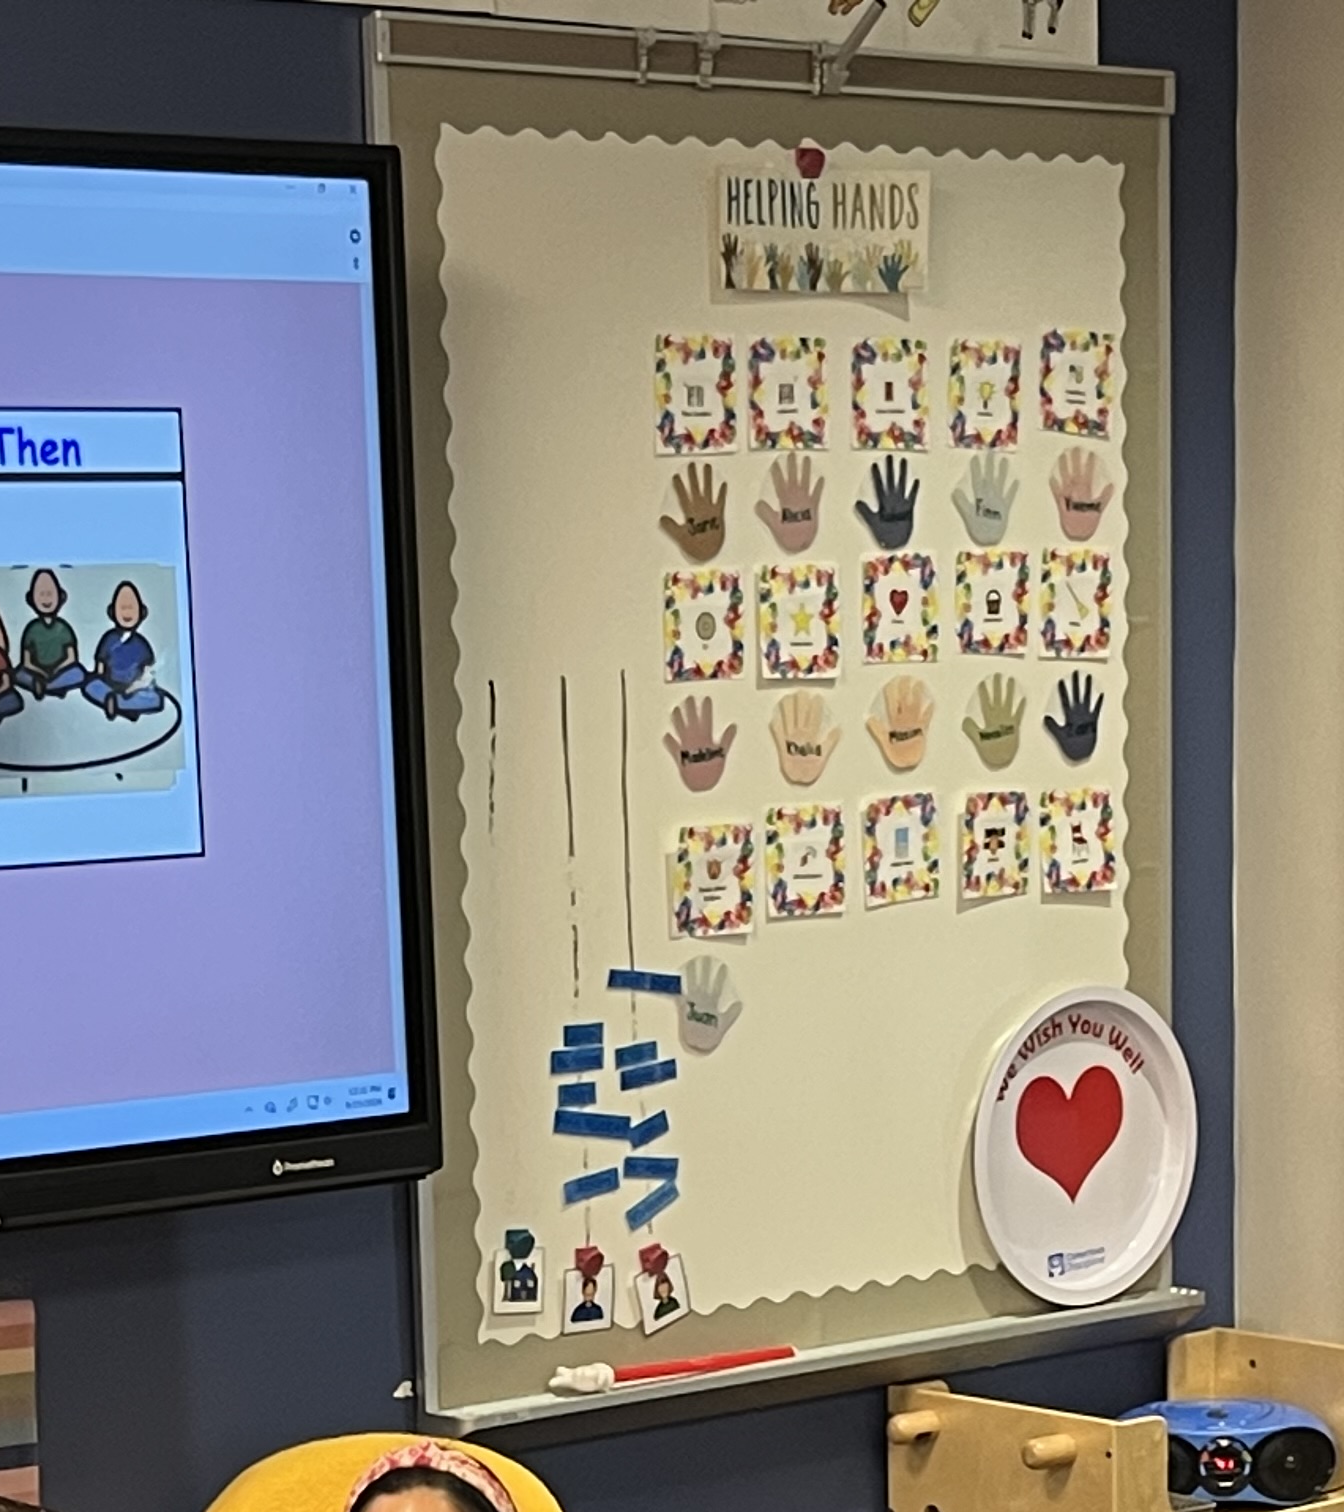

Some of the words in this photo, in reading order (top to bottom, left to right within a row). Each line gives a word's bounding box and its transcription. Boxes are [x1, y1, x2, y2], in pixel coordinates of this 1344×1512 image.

[725, 176, 821, 230] HELPING
[831, 181, 920, 232] HANDS
[1017, 1017, 1064, 1061] Wish
[1067, 1013, 1105, 1039] You
[1107, 1025, 1146, 1075] Well
